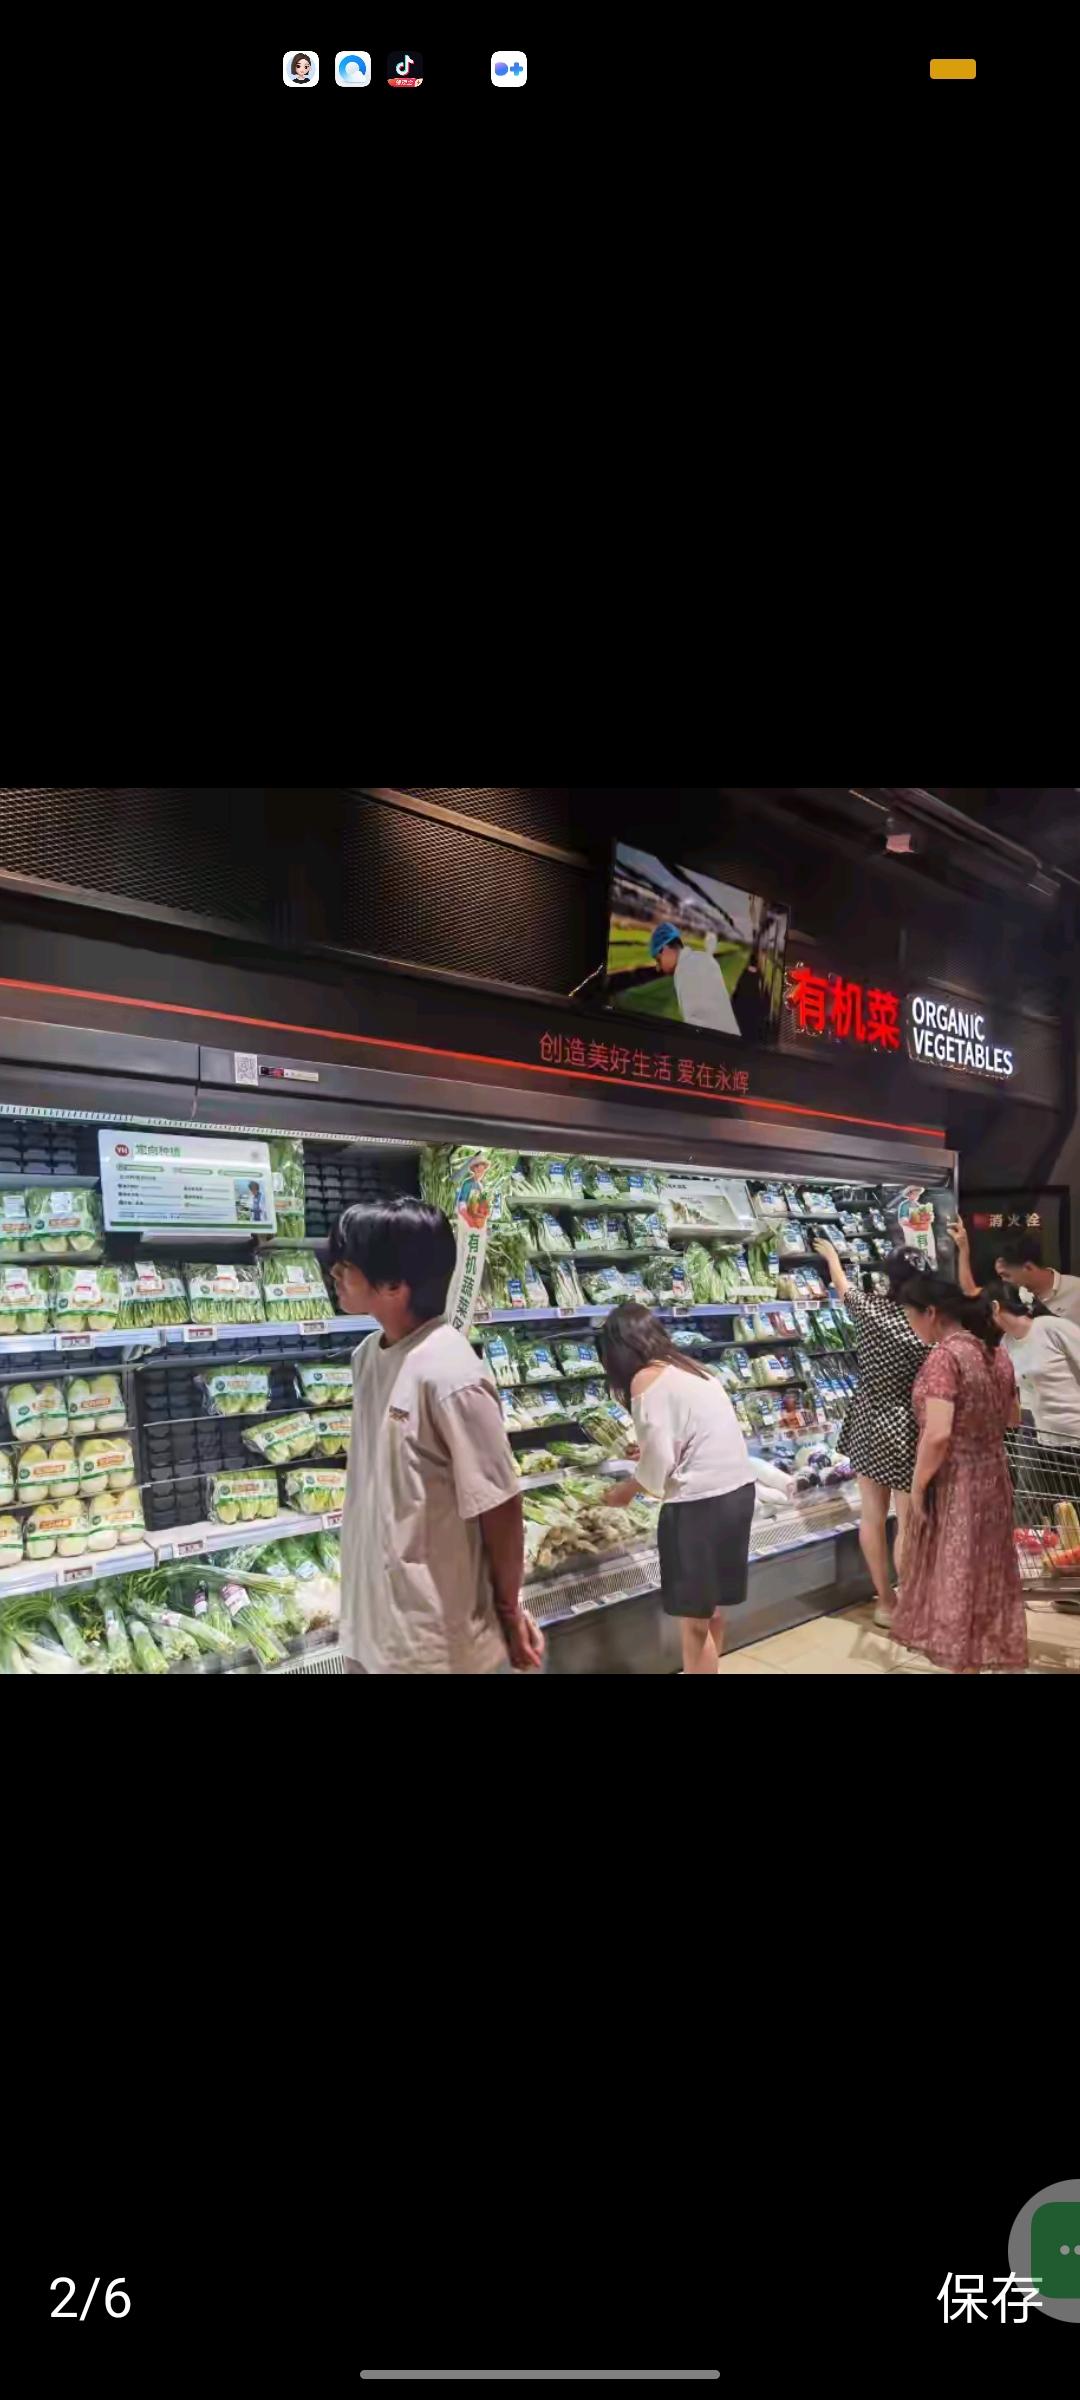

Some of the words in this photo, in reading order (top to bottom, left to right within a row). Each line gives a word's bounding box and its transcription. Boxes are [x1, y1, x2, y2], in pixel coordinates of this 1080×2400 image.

[790, 967, 901, 1048] 有机菜
[911, 996, 985, 1042] ORGANIC
[538, 1031, 672, 1081] 创造美好生活
[676, 1058, 750, 1094] 爱在永辉
[912, 1026, 1014, 1075] VEGETABLES
[989, 1212, 1041, 1228] 消火栓
